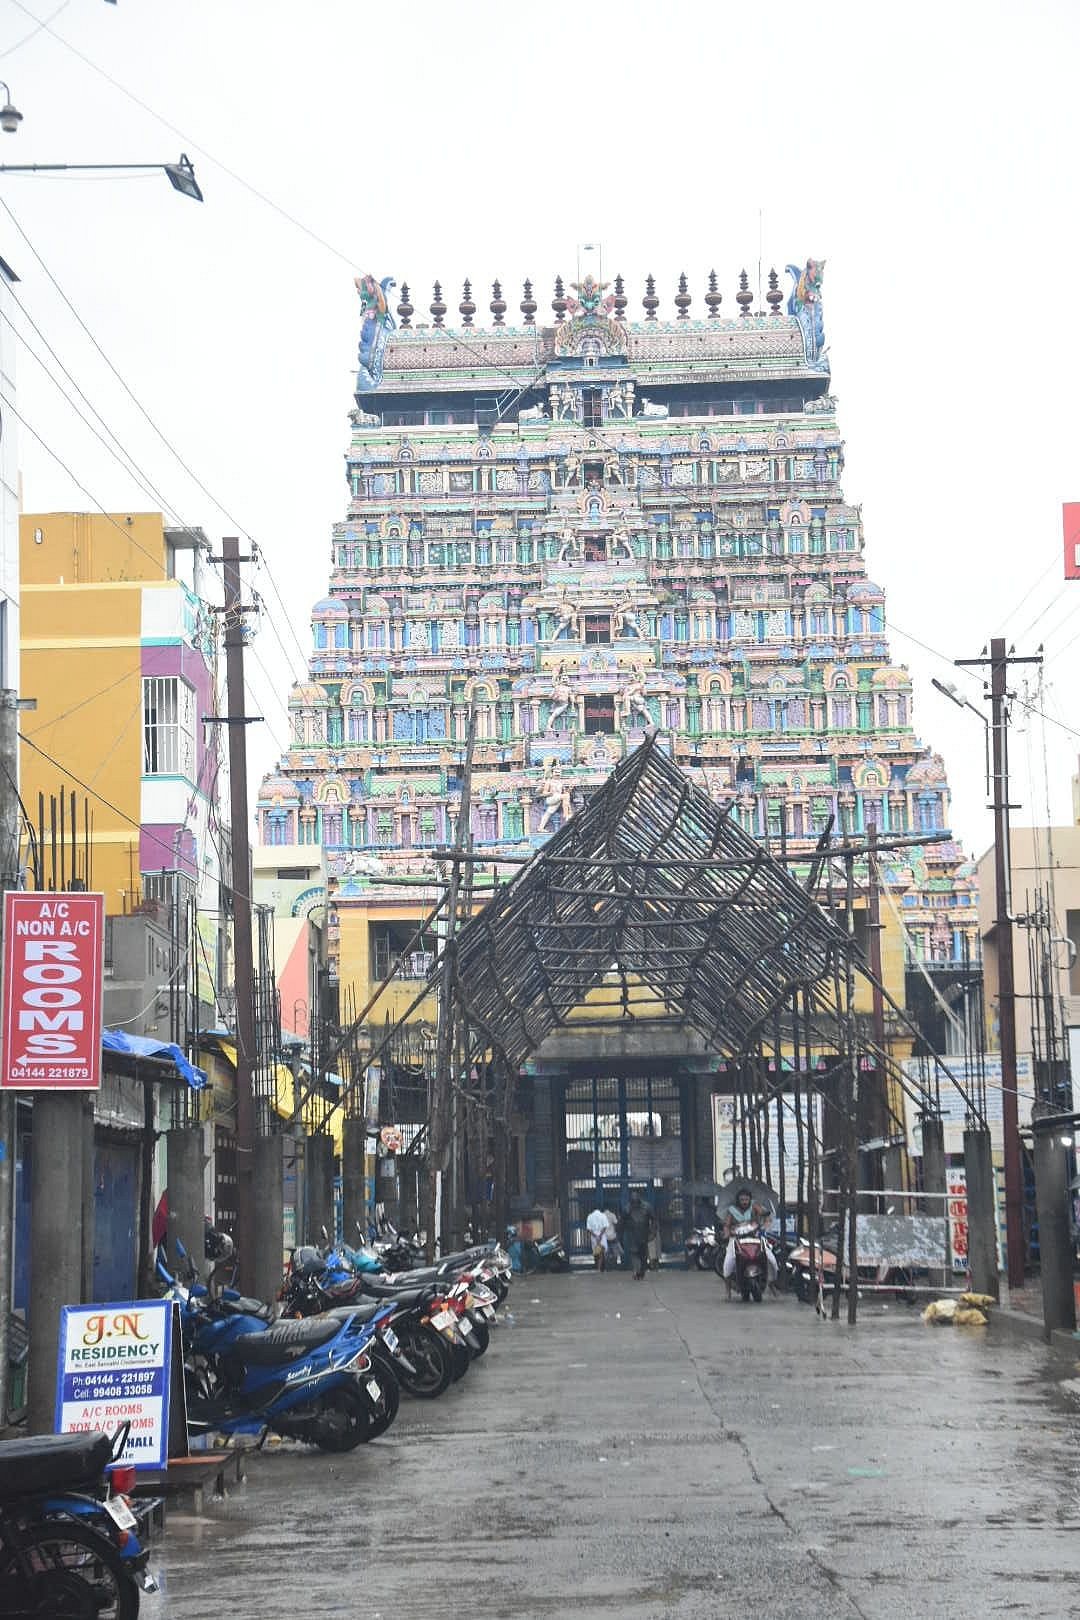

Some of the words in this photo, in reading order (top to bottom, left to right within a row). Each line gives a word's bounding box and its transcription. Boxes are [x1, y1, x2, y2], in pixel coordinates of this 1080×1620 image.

[39, 902, 70, 918] A/C
[16, 920, 55, 936] NON
[60, 920, 90, 936] A/C
[19, 940, 84, 1055] ROOMS
[11, 1067, 45, 1078] 04144
[48, 1067, 89, 1078] 221879
[70, 1343, 160, 1361] RESIDENCY
[82, 1406, 103, 1418] A/C
[105, 1403, 143, 1416] ROOMS
[118, 1418, 154, 1430] ROMS
